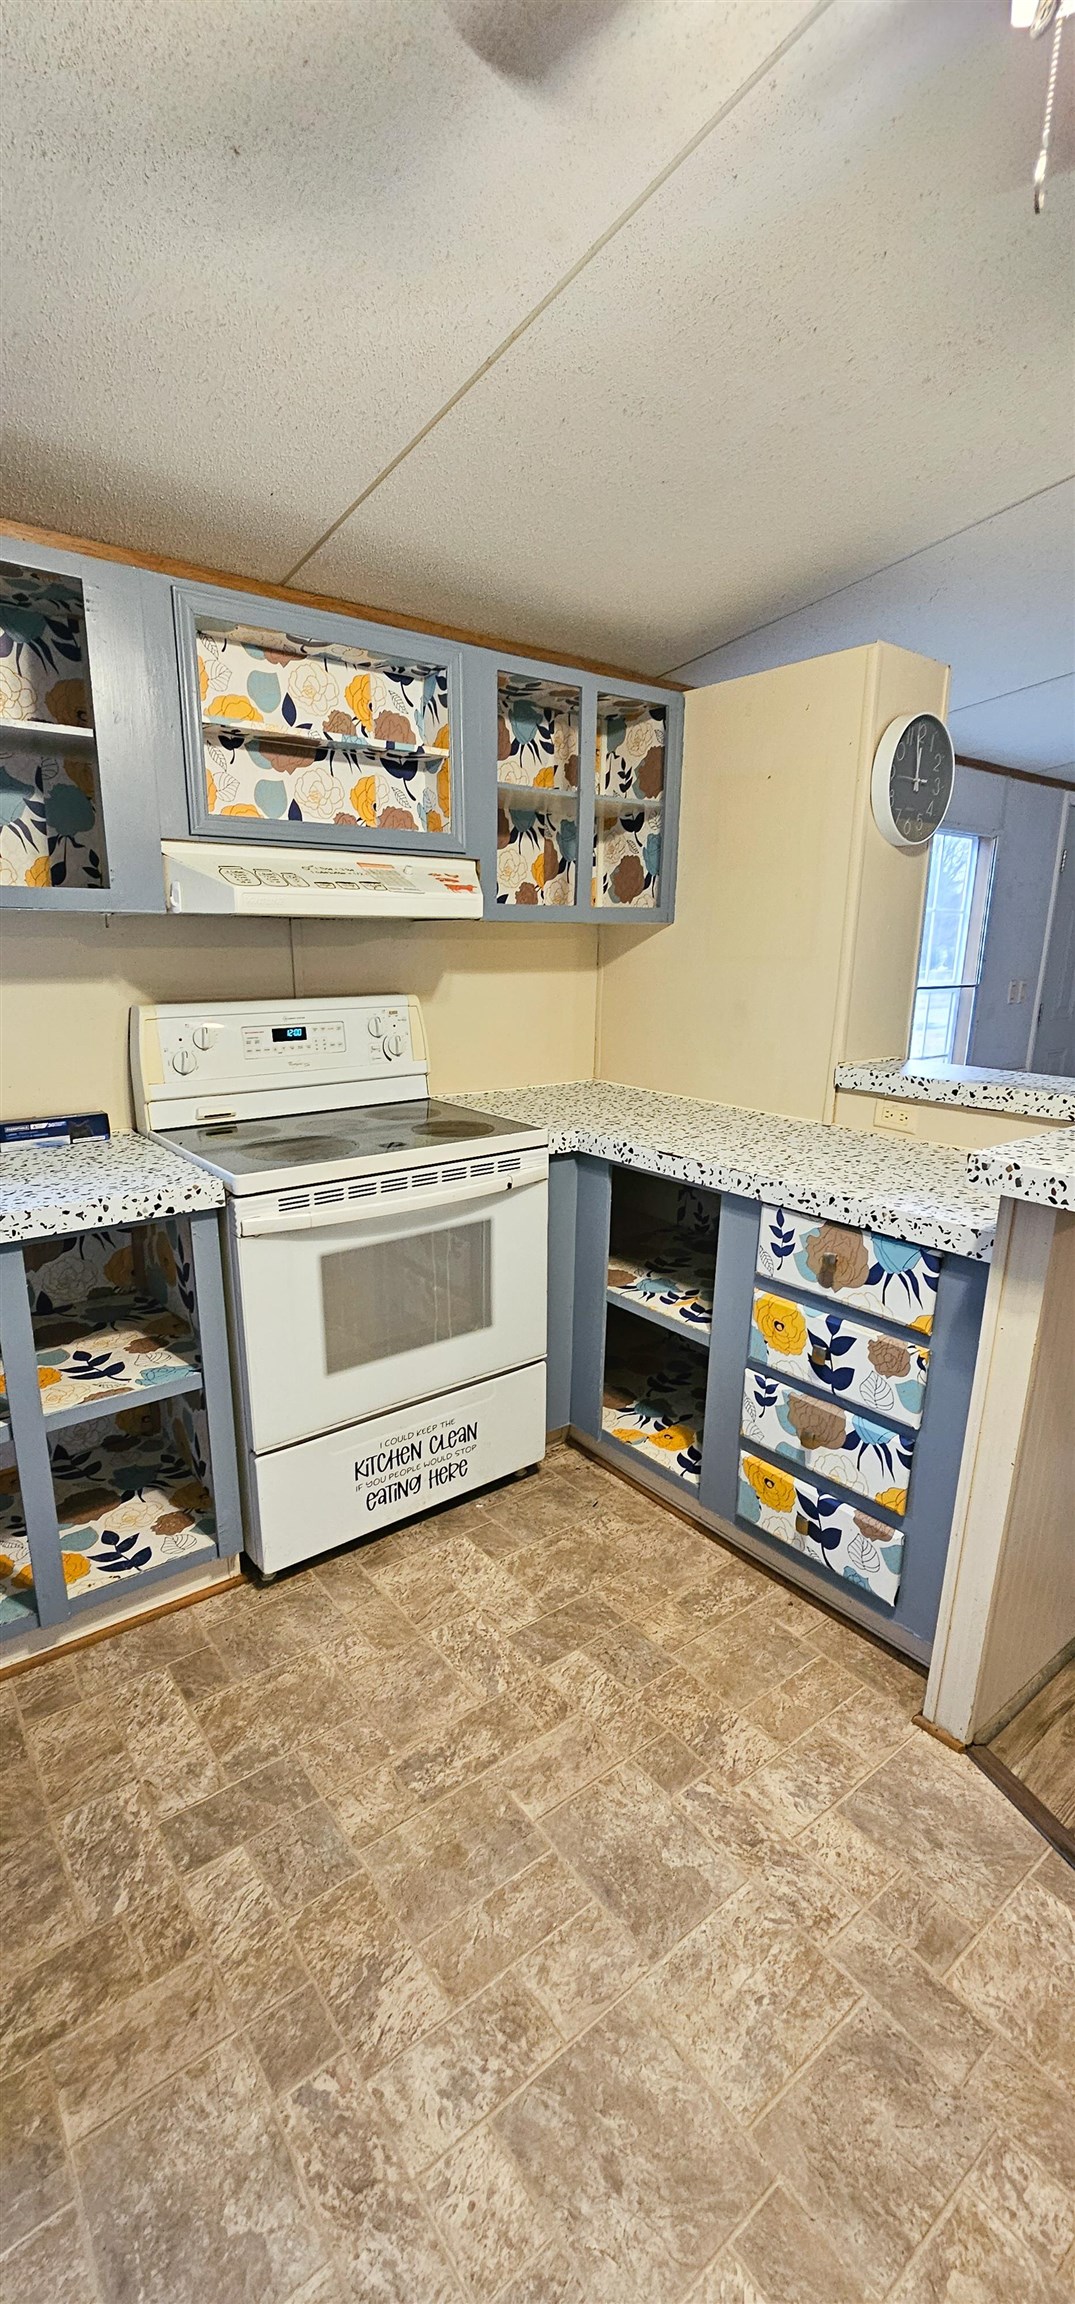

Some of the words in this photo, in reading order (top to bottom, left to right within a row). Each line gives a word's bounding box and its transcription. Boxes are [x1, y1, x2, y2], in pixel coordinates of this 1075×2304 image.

[906, 725, 914, 746] 11
[933, 753, 943, 772] 2
[933, 777, 940, 796] 3
[895, 807, 902, 824] 7
[926, 800, 934, 817] 4
[903, 818, 911, 835] 6
[916, 813, 924, 832] 5
[286, 1028, 302, 1037] 12:00
[384, 1431, 414, 1448] COULD
[416, 1424, 438, 1437] KEEP
[440, 1418, 456, 1428] THE
[366, 1475, 387, 1489] YOU
[388, 1462, 421, 1481] PEOPLE
[423, 1452, 453, 1468] WOULD
[455, 1444, 477, 1457] STOP
